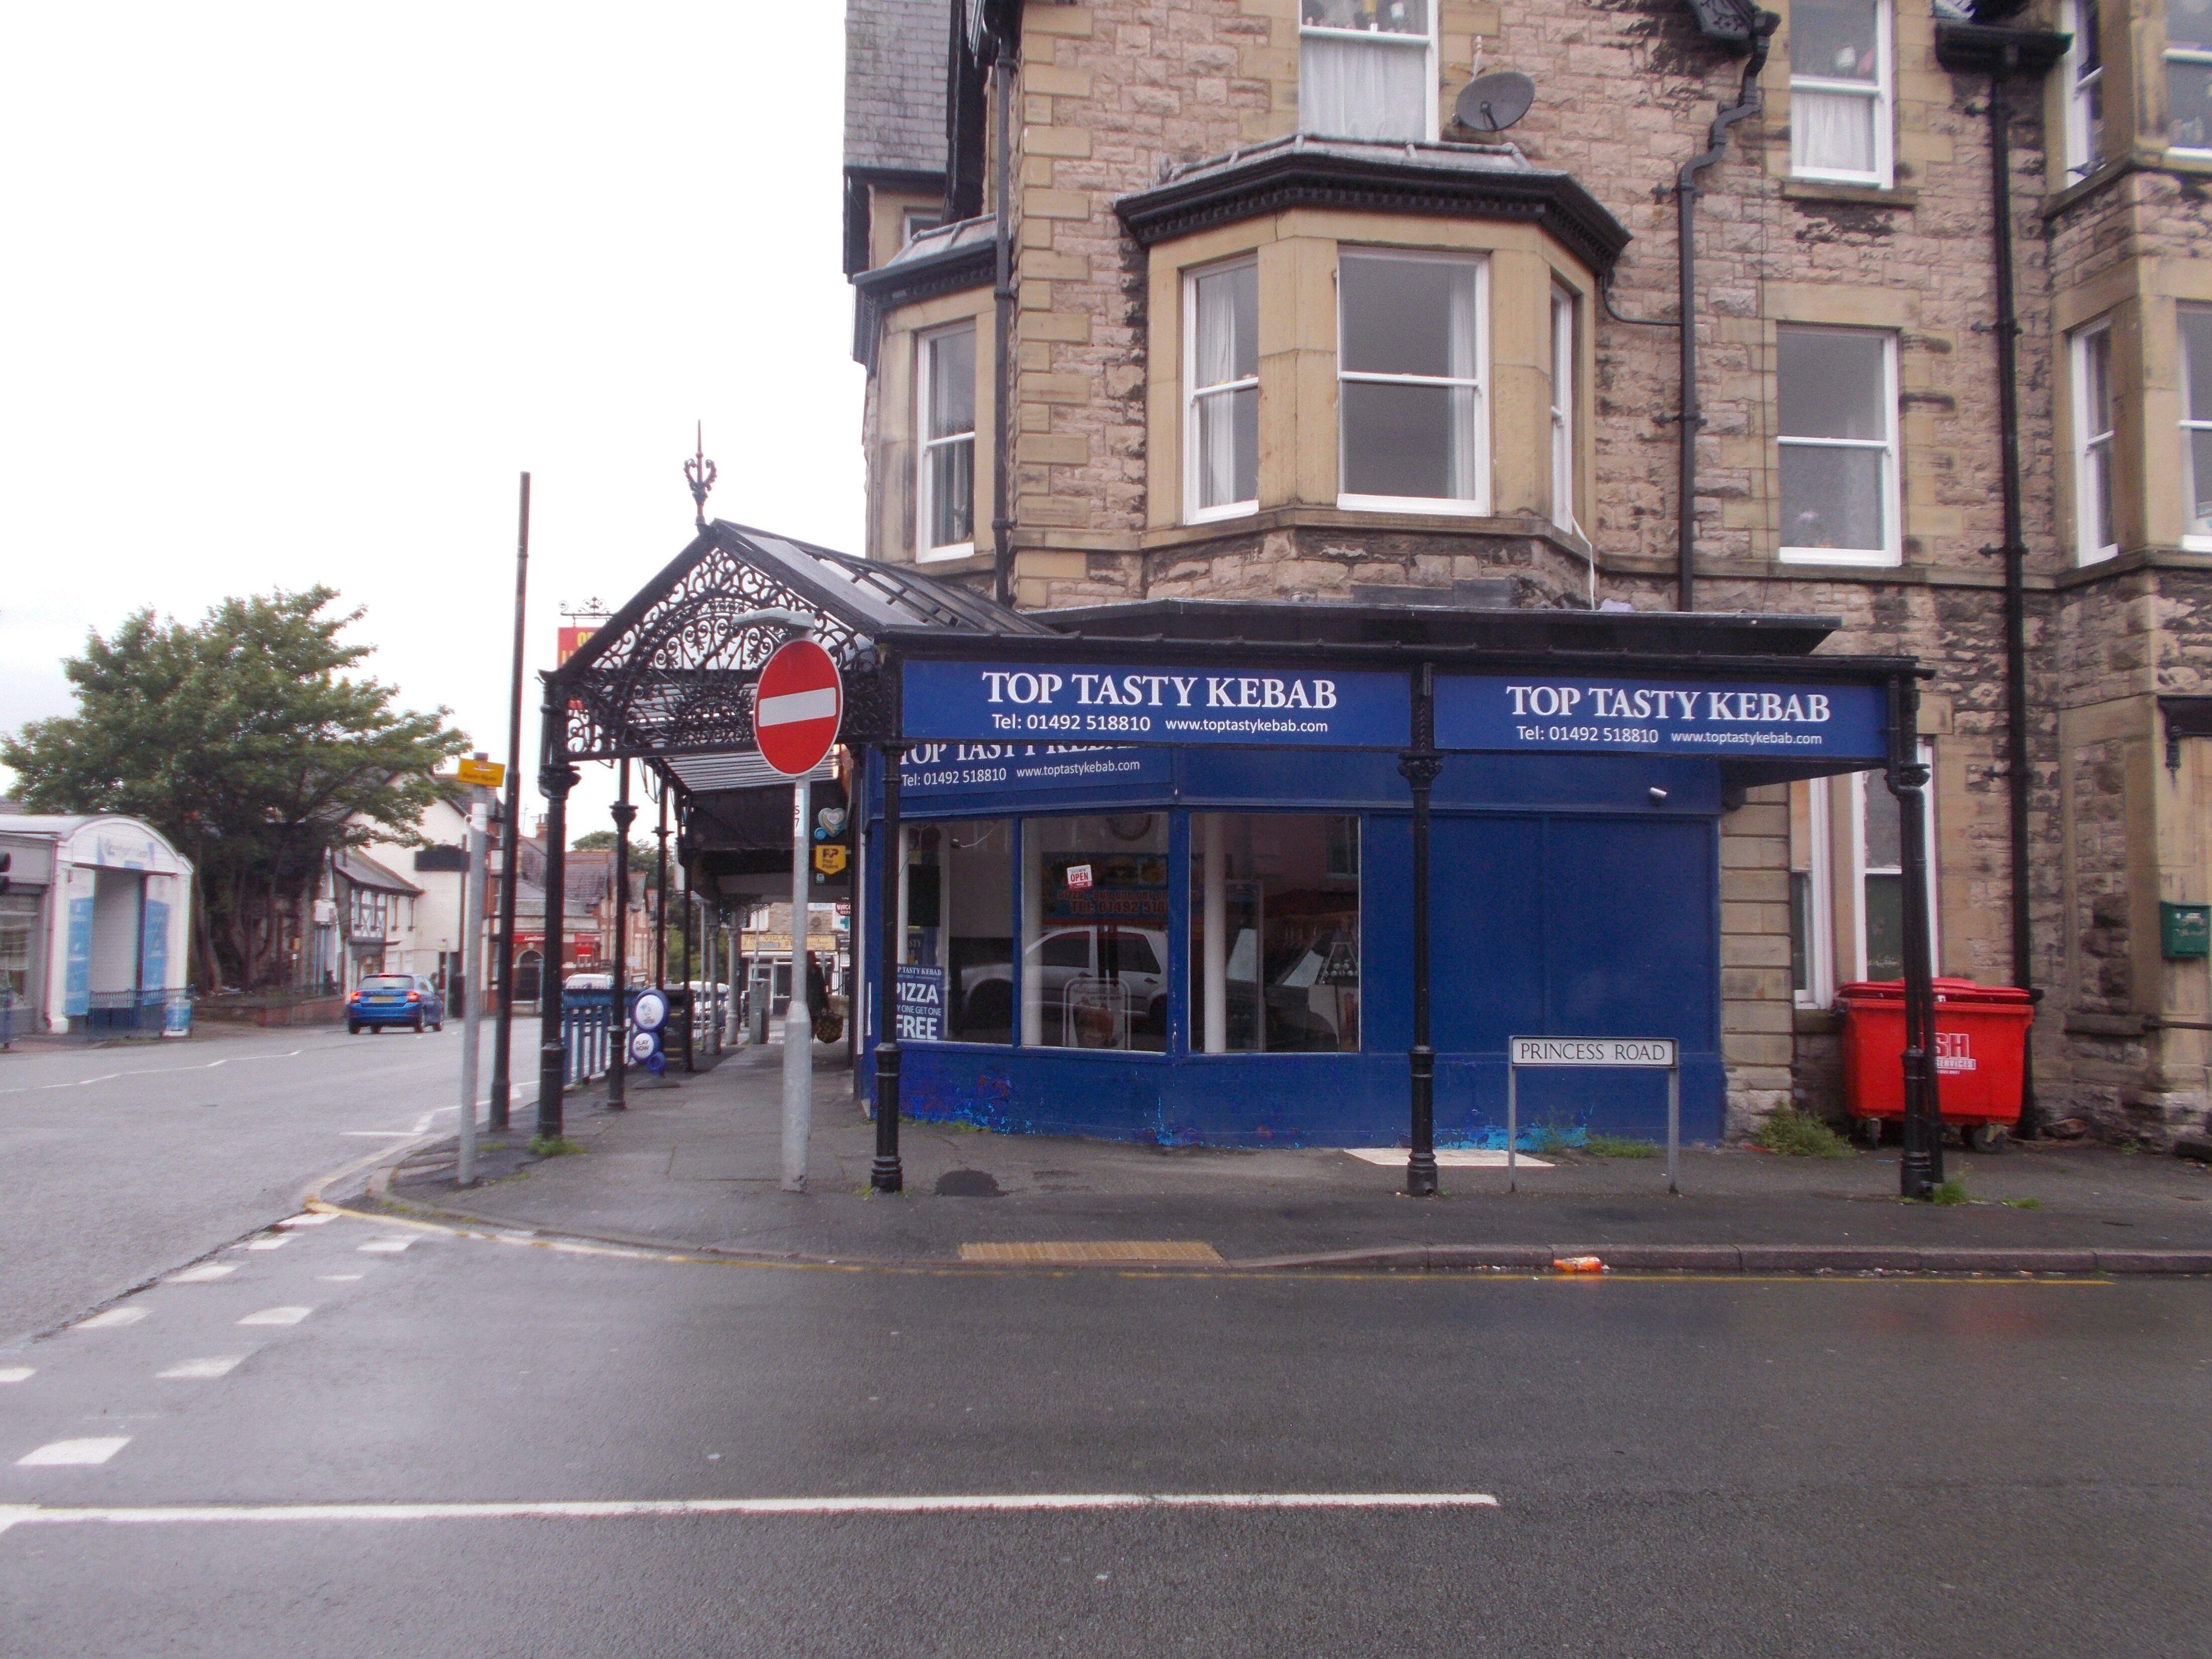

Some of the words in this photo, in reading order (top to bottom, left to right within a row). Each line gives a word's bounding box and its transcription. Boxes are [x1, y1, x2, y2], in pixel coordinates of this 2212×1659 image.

[982, 672, 1063, 703] TOP
[1071, 674, 1199, 706] TASTY
[1206, 677, 1337, 709] KEBAB
[1506, 686, 1581, 716] TOP
[1588, 687, 1701, 720] TASTY
[1707, 692, 1830, 722] KEBAB
[991, 714, 1022, 729] Tel:
[1027, 715, 1081, 730] 01492
[1086, 716, 1151, 731] 518810
[1165, 719, 1329, 734] www.toptastykebab.com
[1516, 726, 1545, 740] Tel:
[1549, 727, 1598, 741] 01492
[1603, 728, 1658, 743] 518810
[1671, 731, 1822, 745] www.toptastykebab.com
[902, 772, 920, 786] Tel:
[924, 771, 959, 785] 01492
[963, 768, 1006, 783] 518810
[1017, 760, 1140, 778] www.toptastykebab.com
[1071, 872, 1089, 882] OPEN
[1098, 900, 1140, 914] 01492
[902, 966, 920, 974] TASTY
[921, 968, 942, 976] KEBAB
[901, 1005, 914, 1013] ONE
[915, 1006, 927, 1014] GET
[928, 1007, 942, 1016] ONE
[1520, 1043, 1604, 1059] PRINCESS
[1615, 1044, 1665, 1060] ROAD
